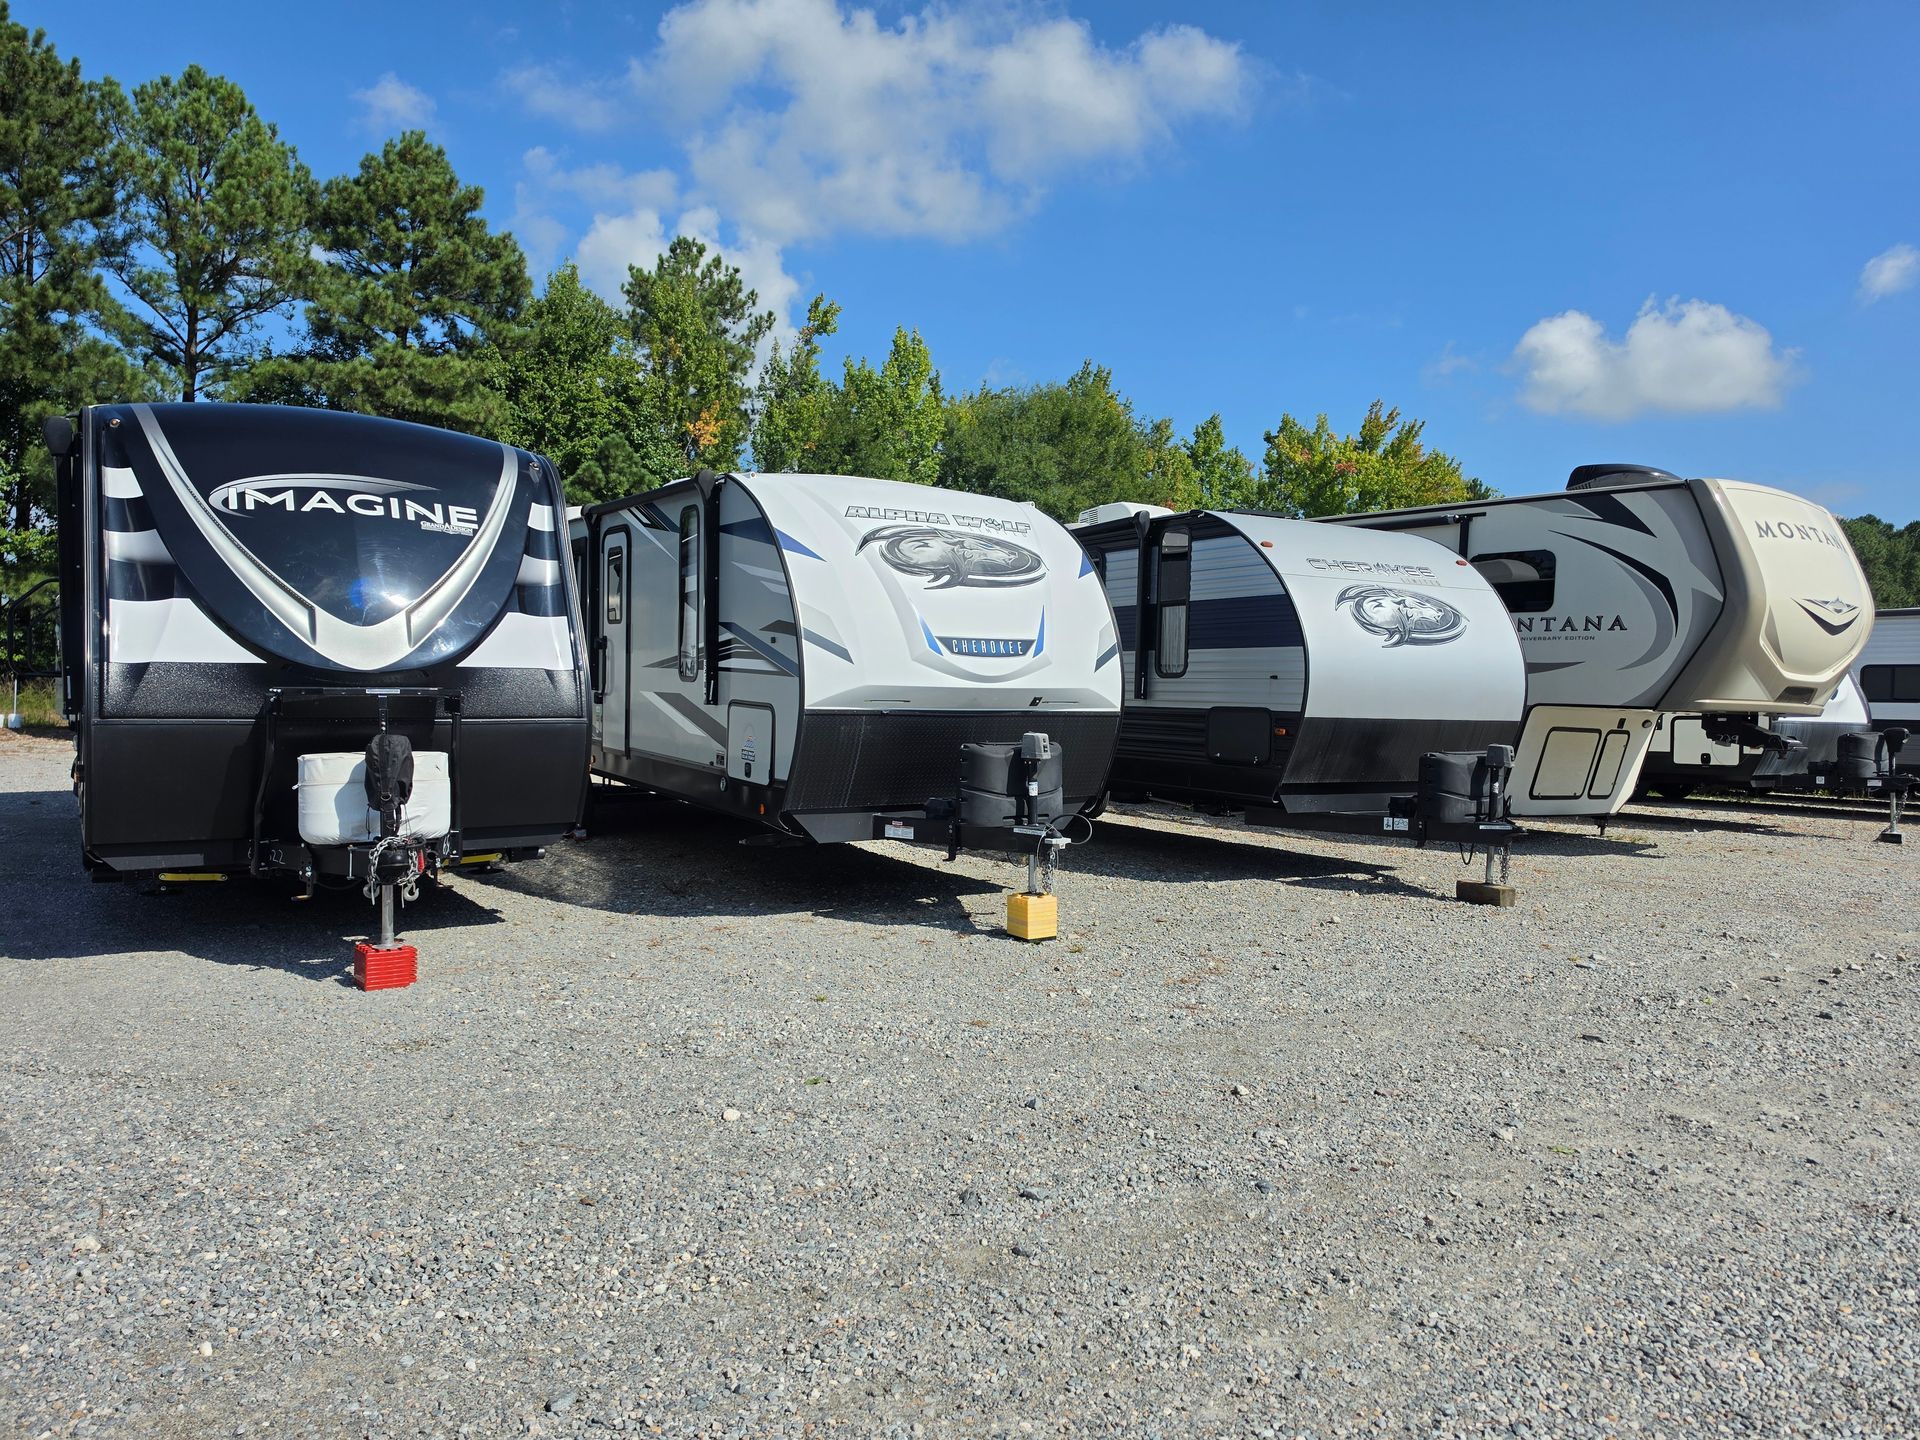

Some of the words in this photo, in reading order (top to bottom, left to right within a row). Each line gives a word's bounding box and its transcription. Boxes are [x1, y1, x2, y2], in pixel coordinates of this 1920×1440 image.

[227, 487, 479, 530] IMAGINE
[844, 505, 950, 525] ALPHA
[1754, 520, 1848, 554] MONTAN
[1517, 614, 1628, 633] NTANA
[952, 639, 1024, 655] CHEROKEE
